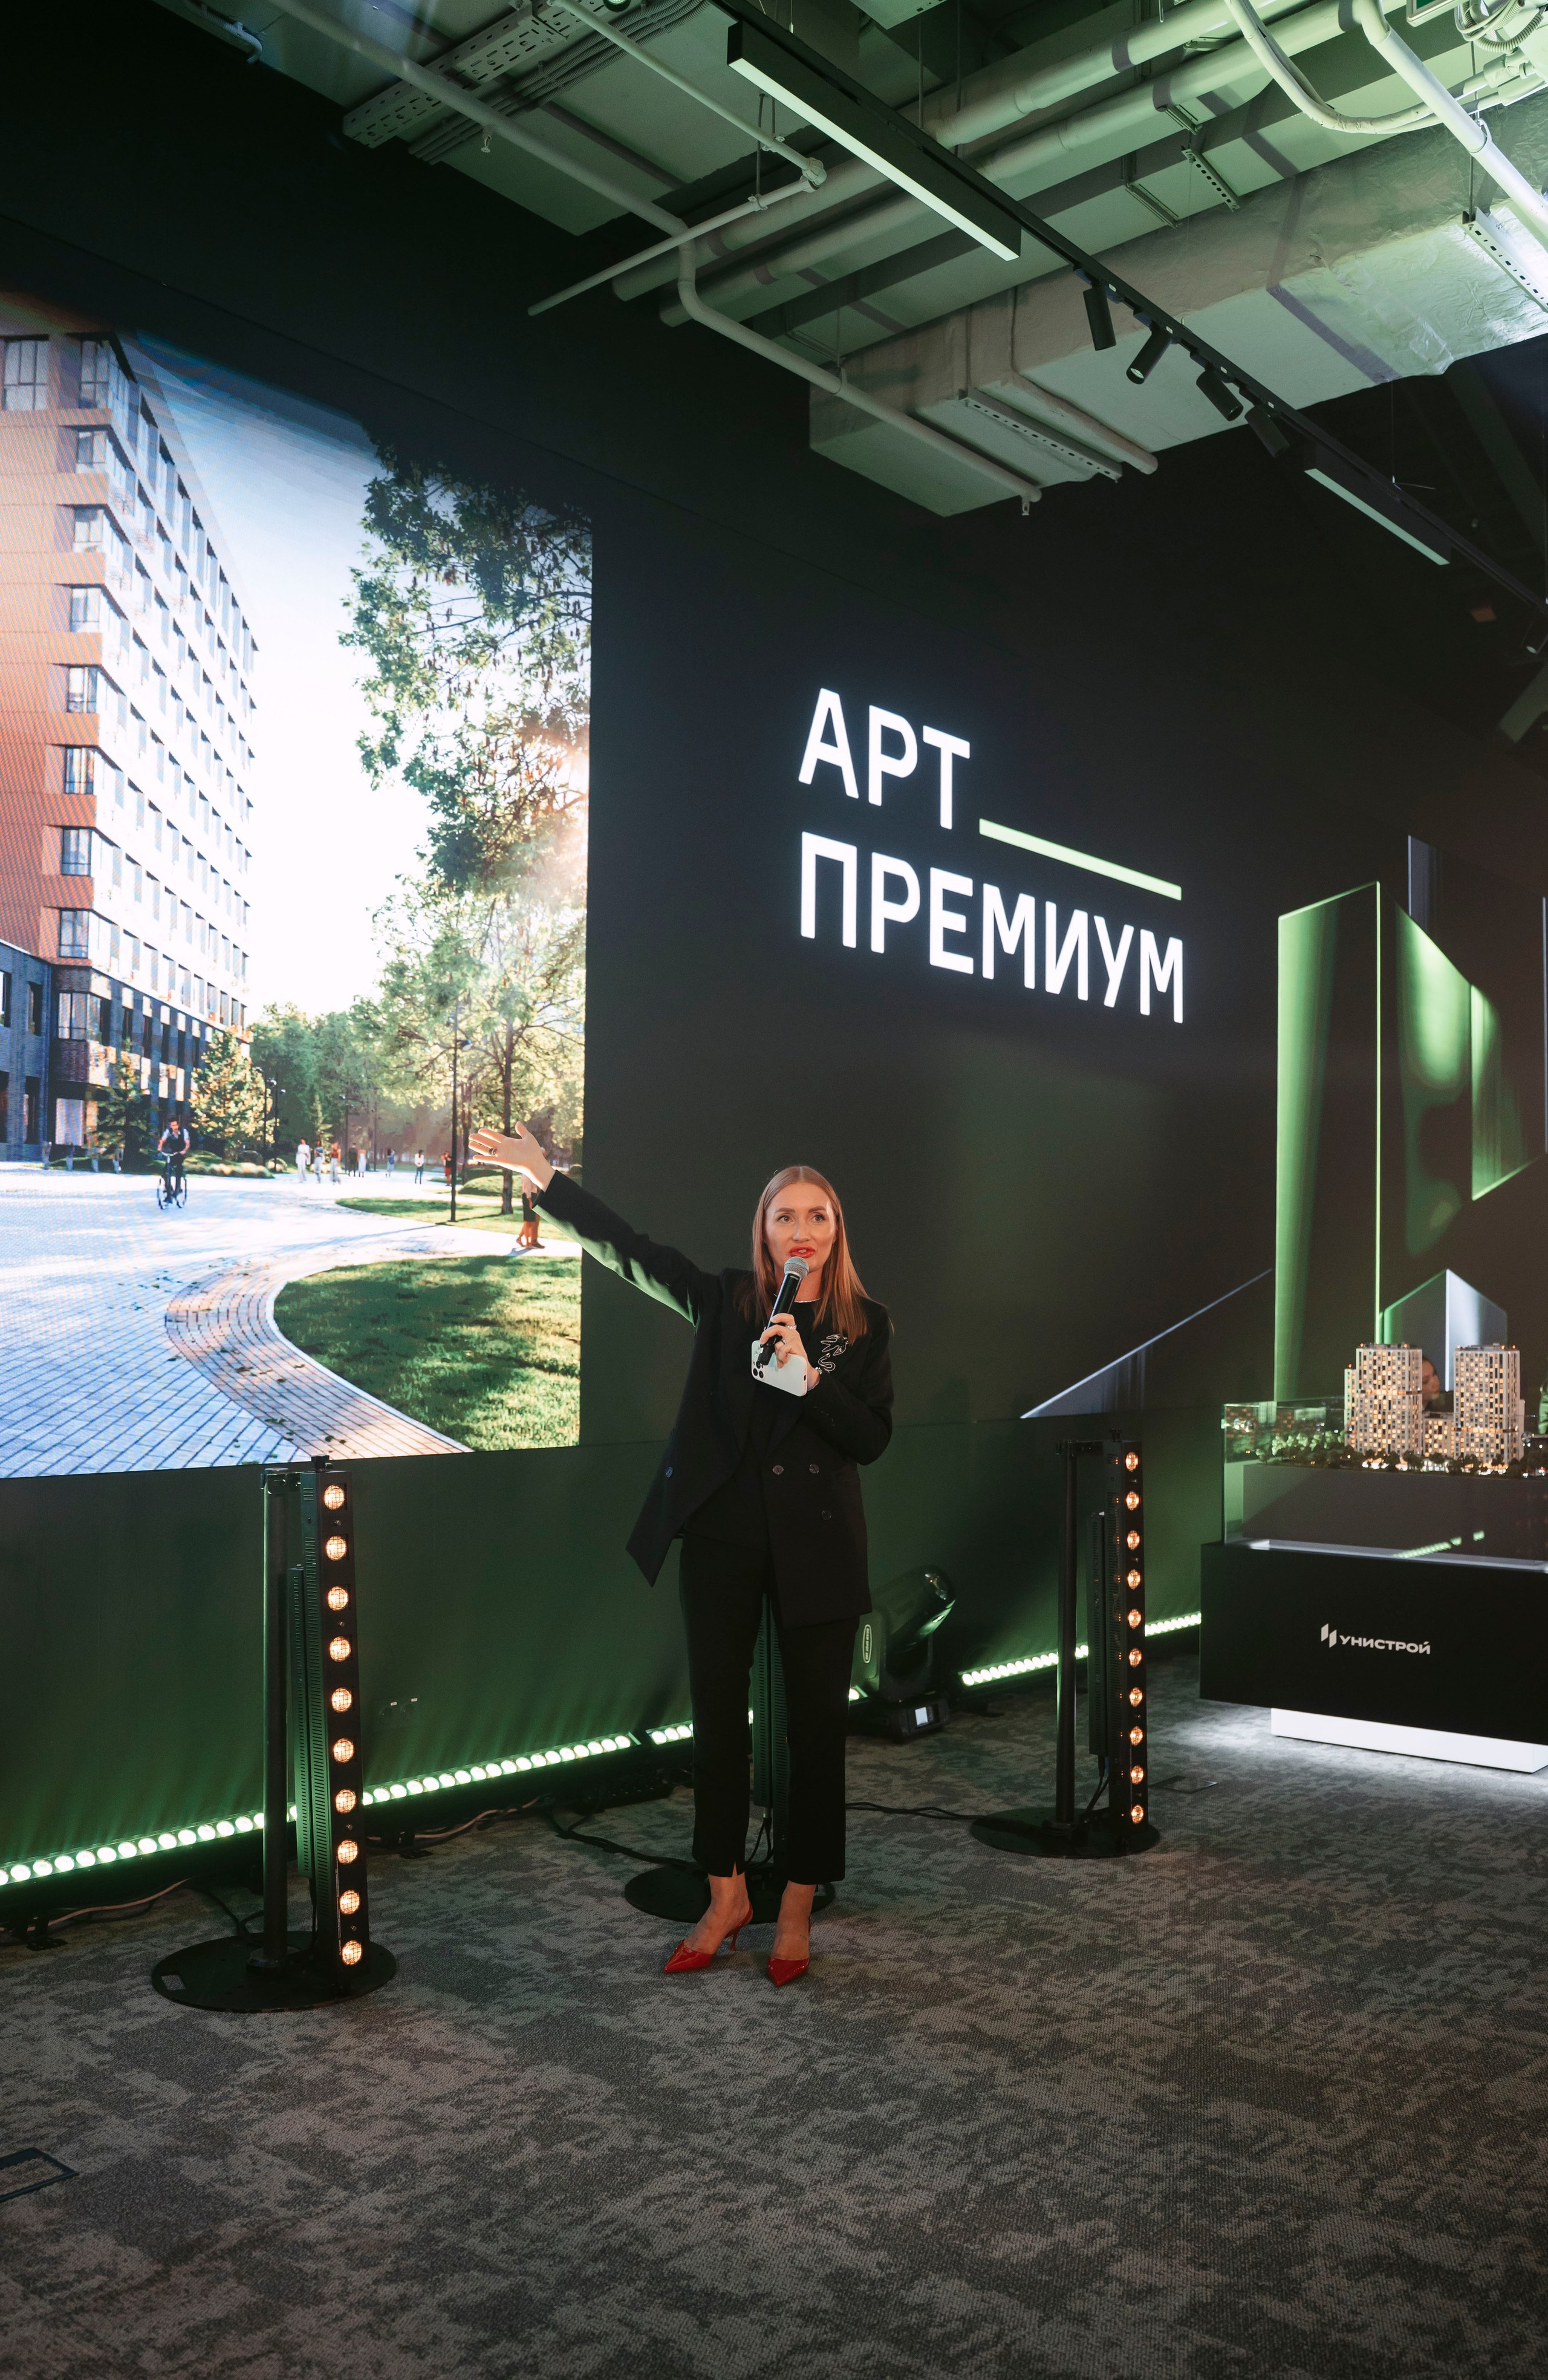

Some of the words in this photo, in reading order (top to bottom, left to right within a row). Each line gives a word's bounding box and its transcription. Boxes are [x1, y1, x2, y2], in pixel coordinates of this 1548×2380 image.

[798, 688, 971, 830] АРТ
[800, 831, 1183, 1024] ПРЕМИУМ
[1339, 1634, 1431, 1655] УНИСТРОЙ
